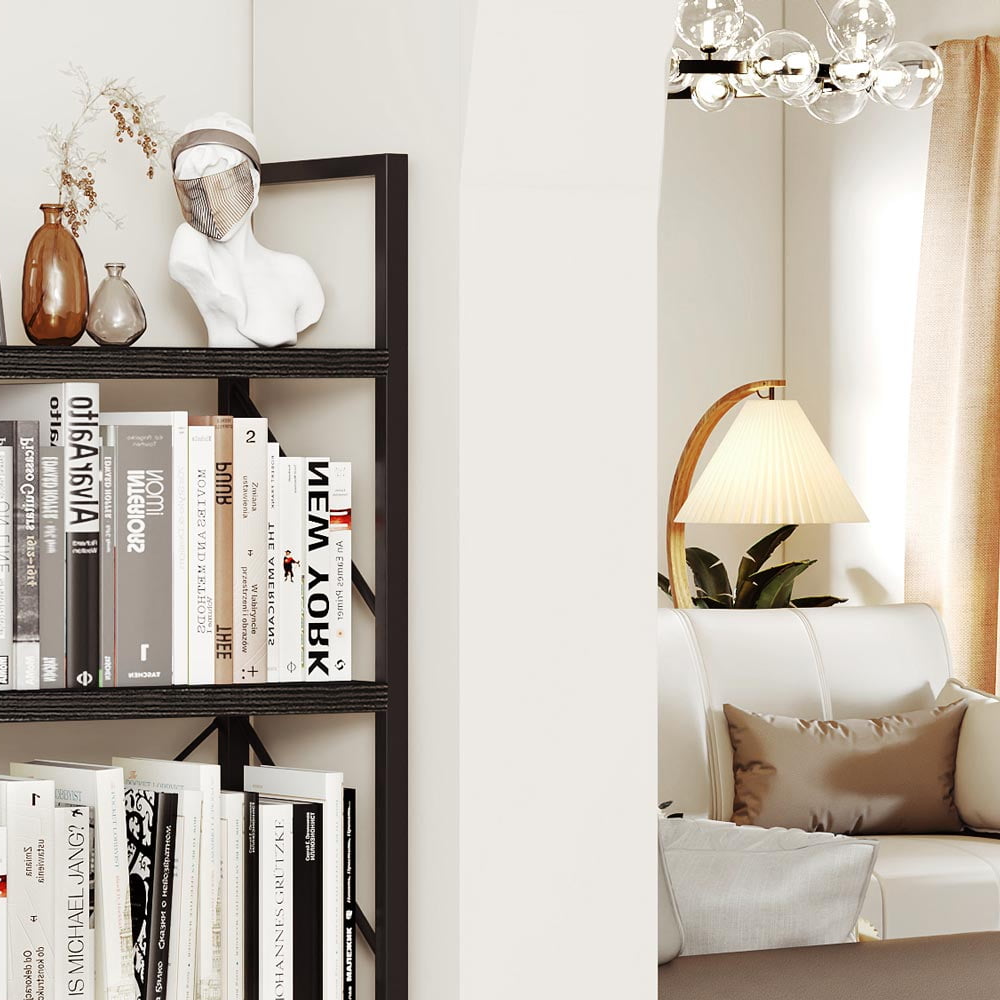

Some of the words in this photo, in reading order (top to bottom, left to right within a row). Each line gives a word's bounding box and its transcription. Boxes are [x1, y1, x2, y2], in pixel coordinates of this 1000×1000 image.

[245, 429, 256, 443] 2
[251, 482, 259, 512] Zmiana
[67, 825, 85, 885] JANG?
[68, 887, 85, 974] MICHAEL
[158, 911, 167, 950] Сказки
[68, 979, 85, 996] IS
